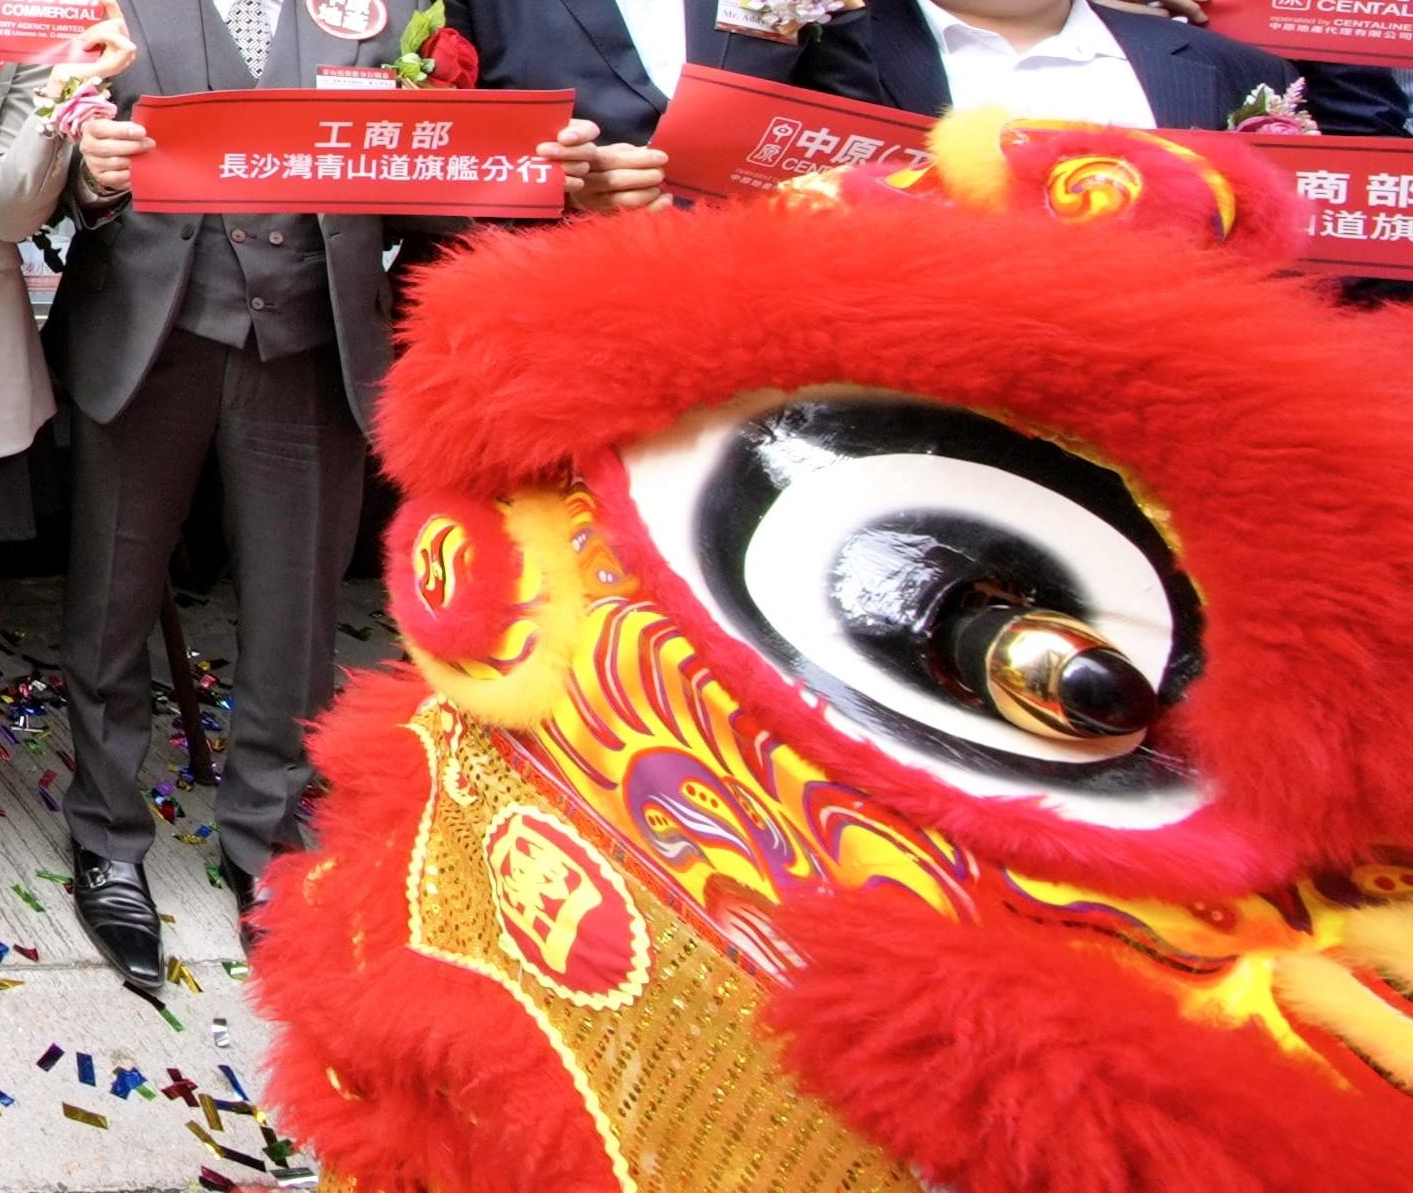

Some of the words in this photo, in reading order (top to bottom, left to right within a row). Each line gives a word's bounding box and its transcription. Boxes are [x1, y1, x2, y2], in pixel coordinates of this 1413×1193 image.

[2, 2, 101, 21] COMMERCIAL
[1333, 19, 1412, 31] CENTALINE
[313, 120, 454, 150] 工商部
[219, 153, 553, 184] 長沙灣青山道旗艦分行
